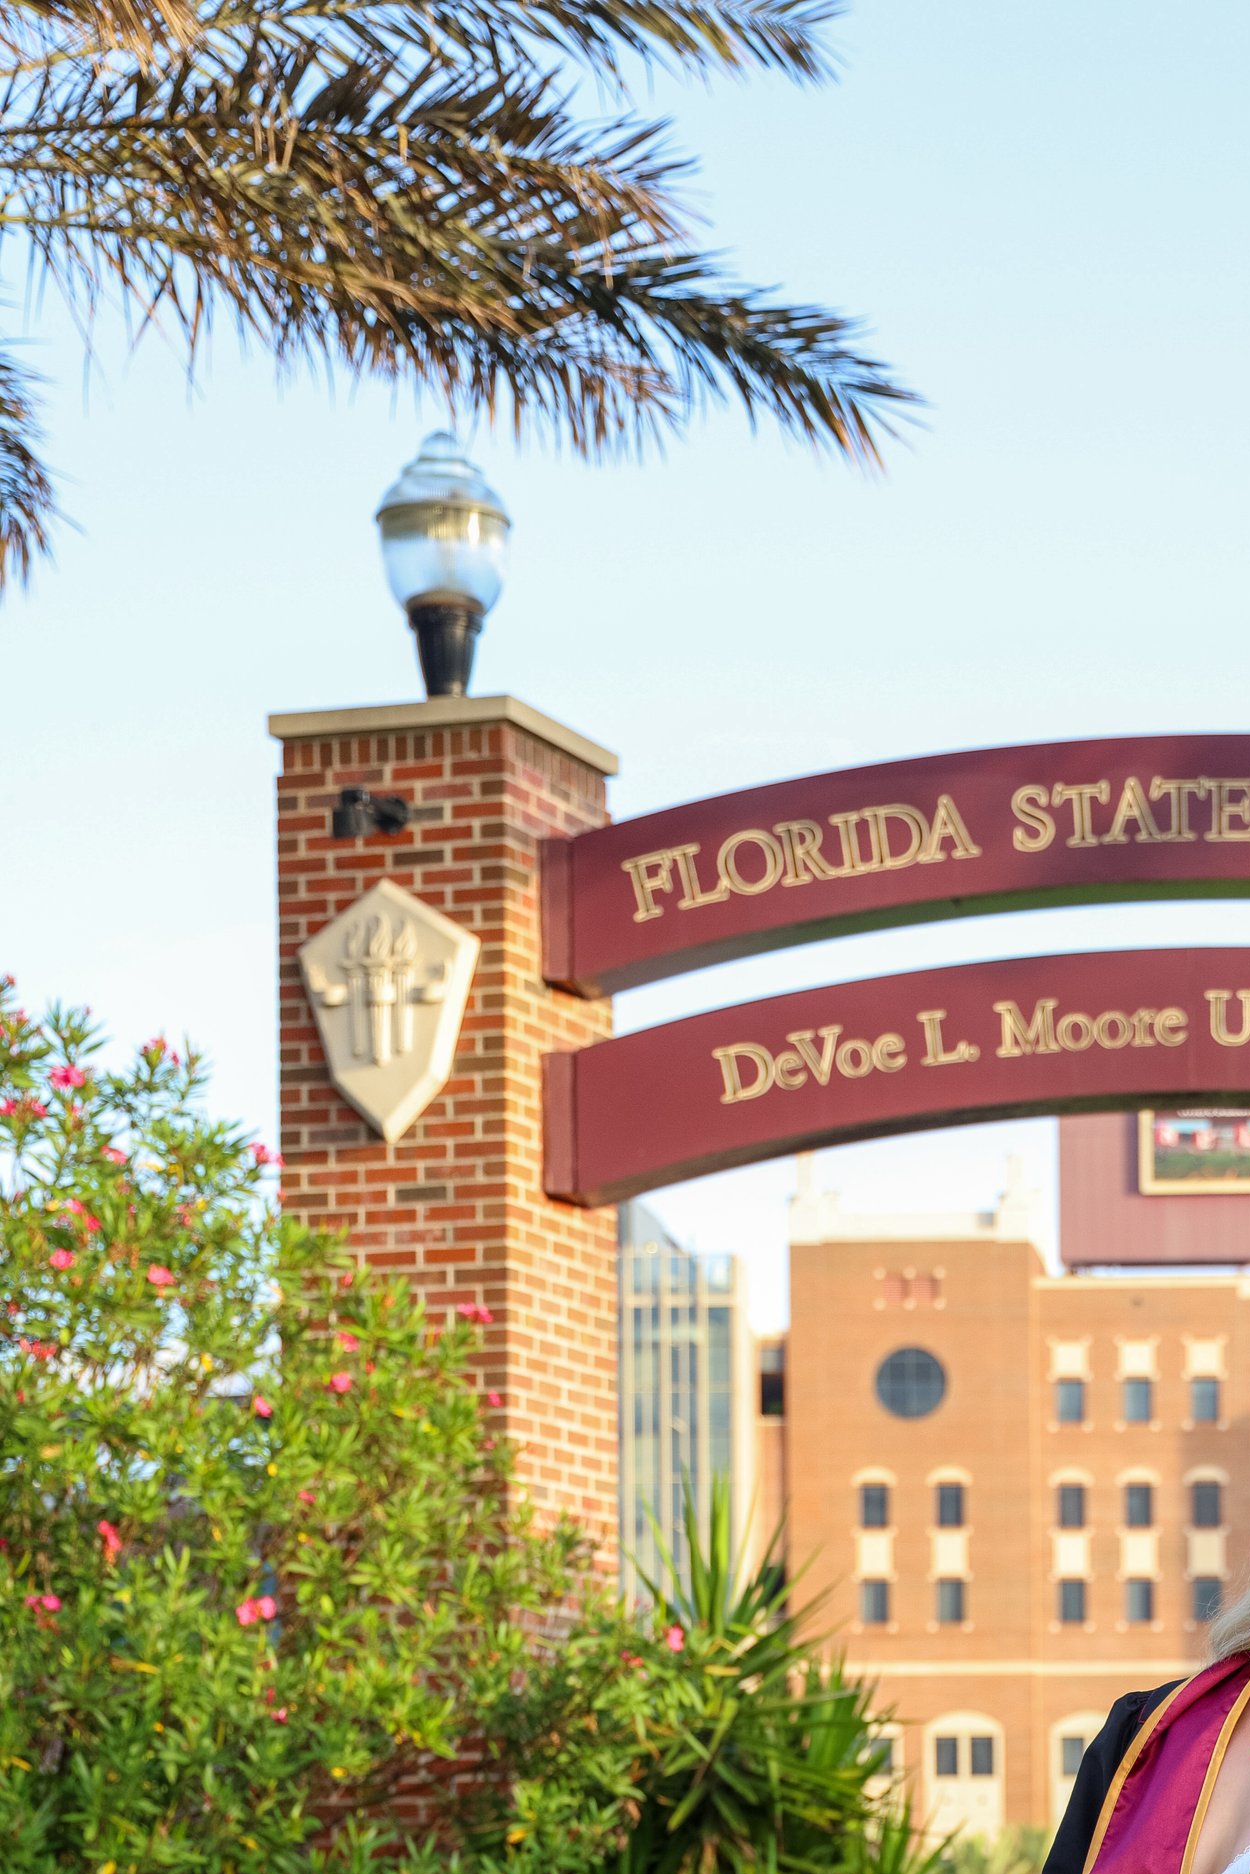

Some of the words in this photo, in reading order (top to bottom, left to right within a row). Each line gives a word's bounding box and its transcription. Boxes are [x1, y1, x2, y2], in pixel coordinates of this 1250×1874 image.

[621, 794, 983, 923] FLORIDA
[711, 1024, 906, 1105] DeVoe
[916, 1009, 980, 1067] L.
[993, 998, 1188, 1058] Moore
